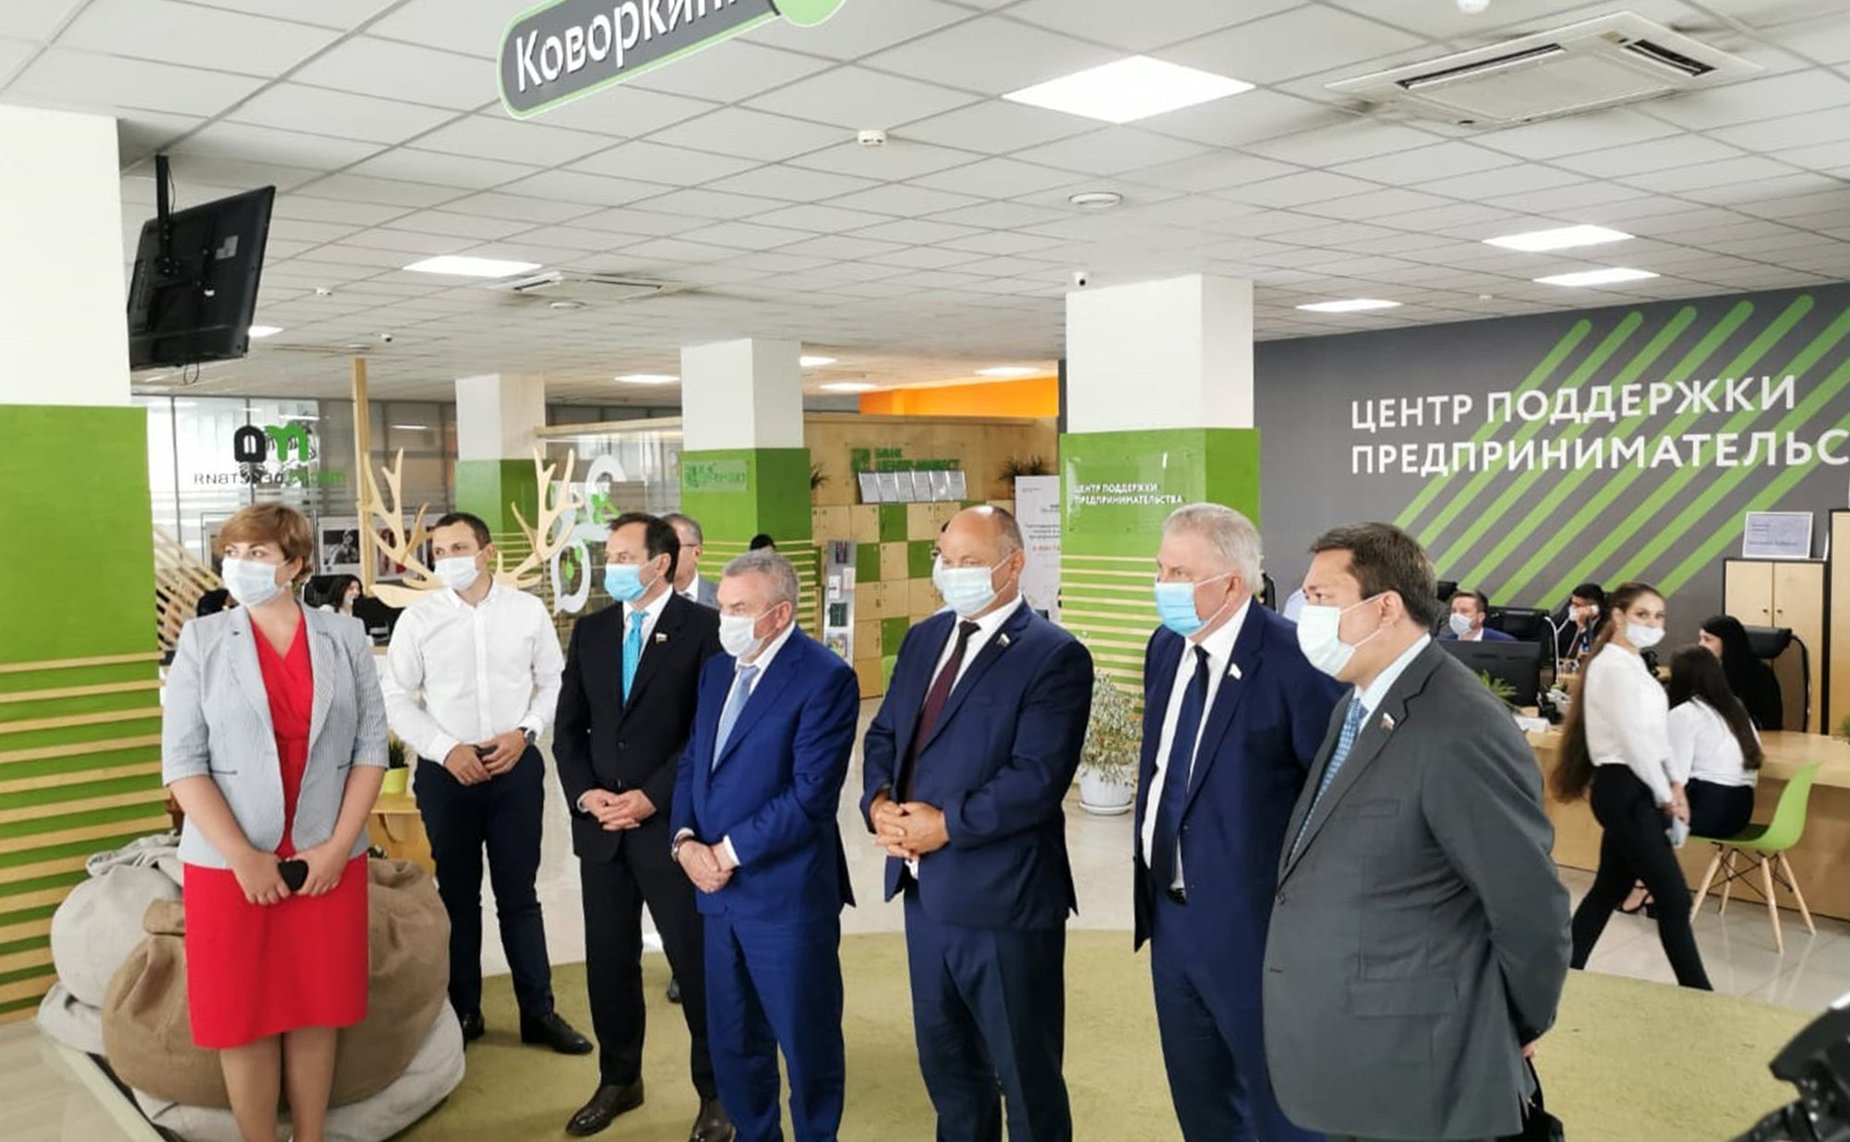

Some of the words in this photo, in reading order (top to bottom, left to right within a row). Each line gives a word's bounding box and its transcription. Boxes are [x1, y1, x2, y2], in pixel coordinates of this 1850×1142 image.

[516, 0, 737, 91] Коворки
[1352, 394, 1473, 433] ЦЕНТР
[1487, 375, 1795, 425] ПОДДЕРЖКИ
[1352, 428, 1850, 477] ПРЕДПРИНИМАТЕЛЬС
[1073, 495, 1183, 506] ПРЕДПРИНИМАТЕЛЬСТВА
[1102, 482, 1158, 493] ПОДДЕРЖКИ
